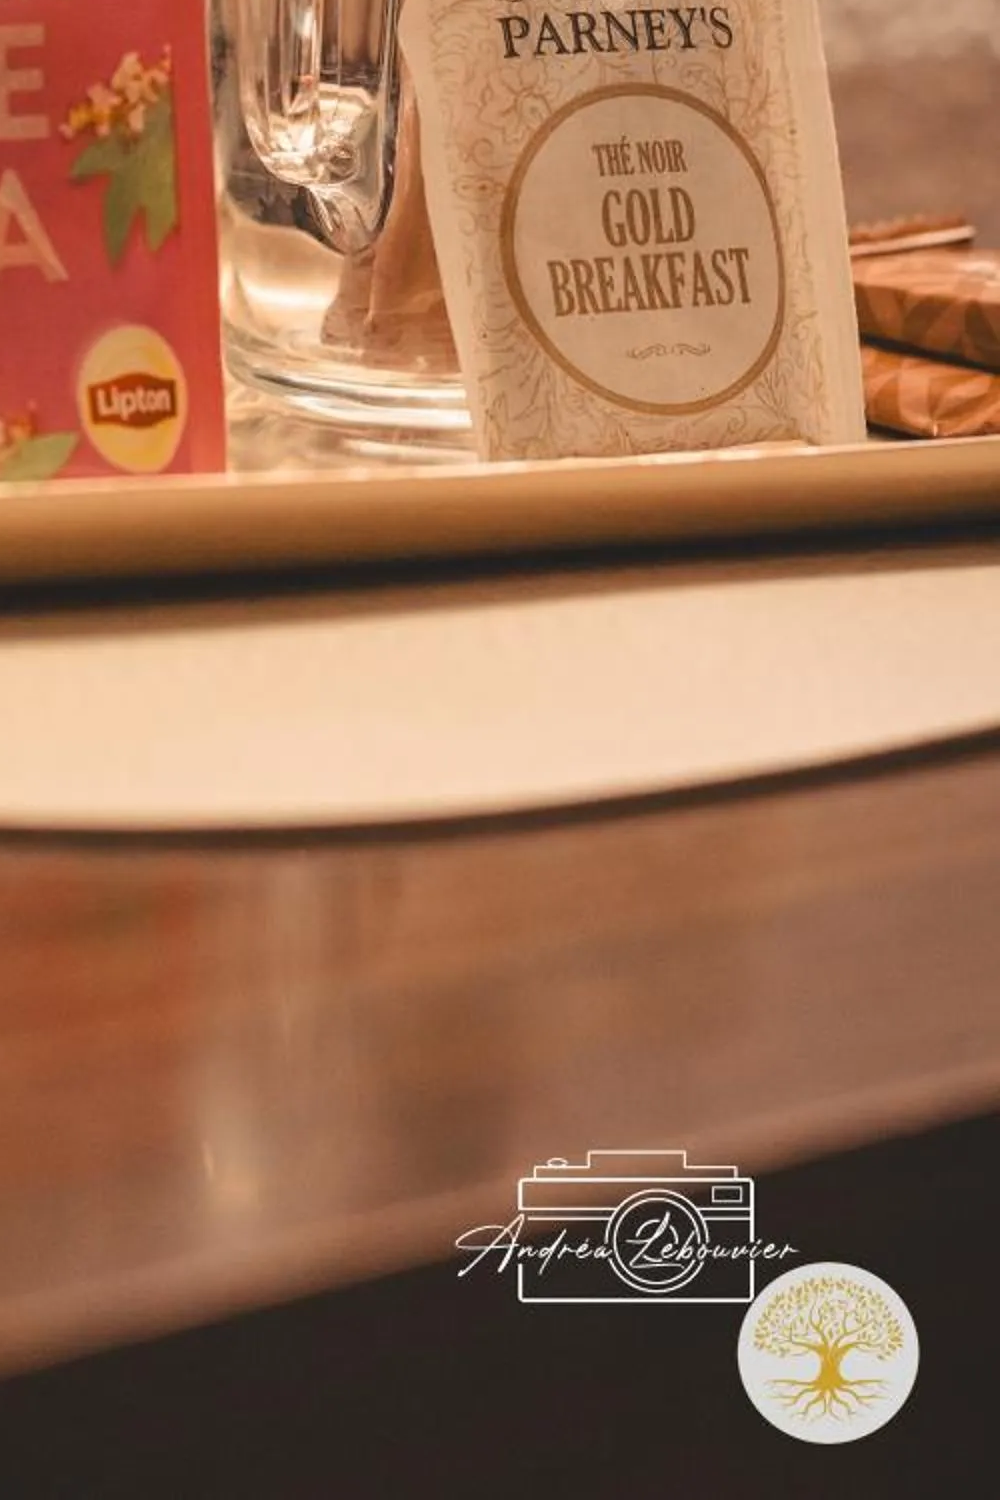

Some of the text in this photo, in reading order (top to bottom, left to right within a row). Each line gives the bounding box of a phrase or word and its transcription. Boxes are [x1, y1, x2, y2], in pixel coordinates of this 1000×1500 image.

[499, 6, 734, 59] PARNEY'S
[593, 135, 687, 178] THÉ NOIR
[600, 186, 696, 248] GOLD
[548, 248, 752, 317] BREAKFAST
[97, 386, 171, 416] Lipton
